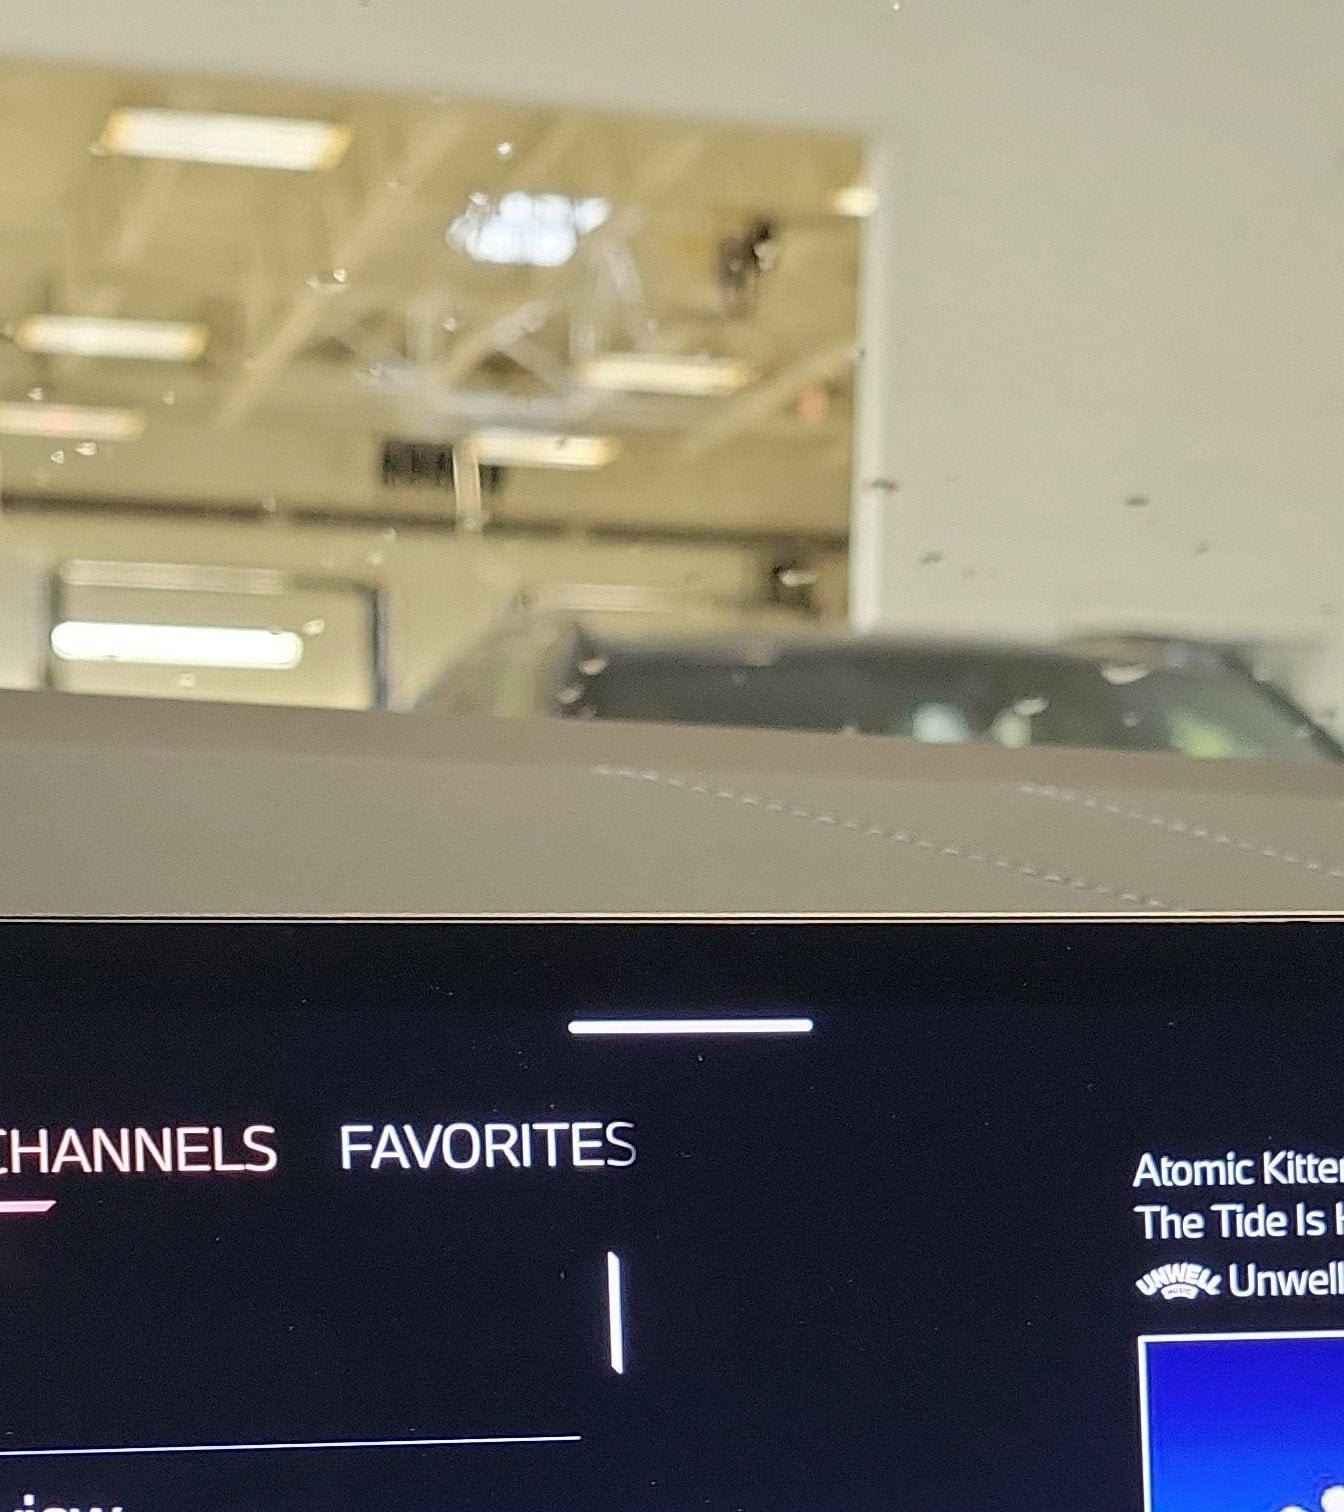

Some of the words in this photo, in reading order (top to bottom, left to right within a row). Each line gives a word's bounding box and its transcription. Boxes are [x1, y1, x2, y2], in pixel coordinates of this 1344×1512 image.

[340, 1121, 637, 1170] FAVORITES
[1132, 1150, 1255, 1188] Atomic
[1133, 1204, 1205, 1240] The
[1209, 1203, 1288, 1238] Tide
[1296, 1202, 1327, 1237] Is
[1136, 1262, 1222, 1296] UNWELL
